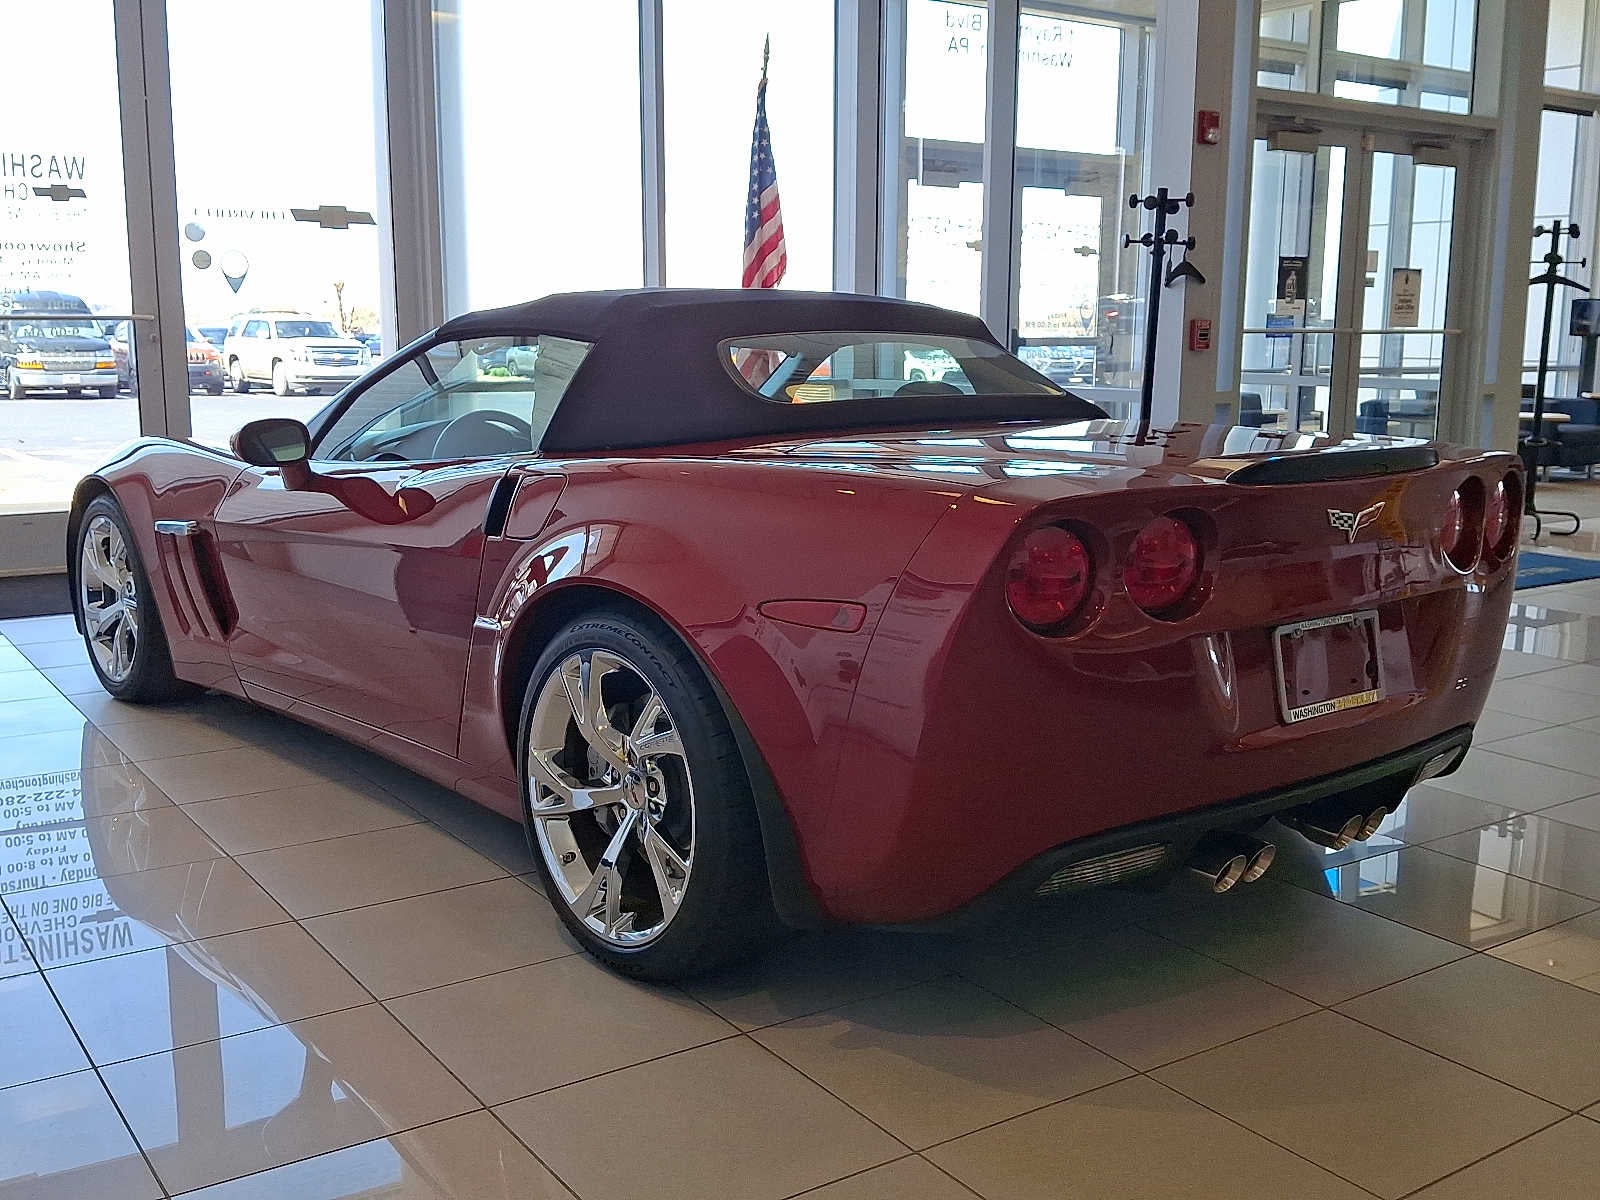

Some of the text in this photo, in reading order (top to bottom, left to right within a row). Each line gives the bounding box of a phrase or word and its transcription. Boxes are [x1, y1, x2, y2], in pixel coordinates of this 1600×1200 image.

[1292, 701, 1336, 720] WASHINGTON
[3, 801, 75, 819] AM to 5:00
[5, 834, 34, 848] 5:00
[38, 832, 51, 842] to
[56, 829, 77, 841] AM
[26, 844, 67, 857] Friday
[7, 859, 36, 872] 8:00
[40, 857, 53, 868] to
[59, 853, 79, 866] AM
[31, 900, 49, 916] ON
[53, 897, 78, 913] ONE
[82, 893, 103, 909] BIG
[0, 921, 134, 965] WASHINGT
